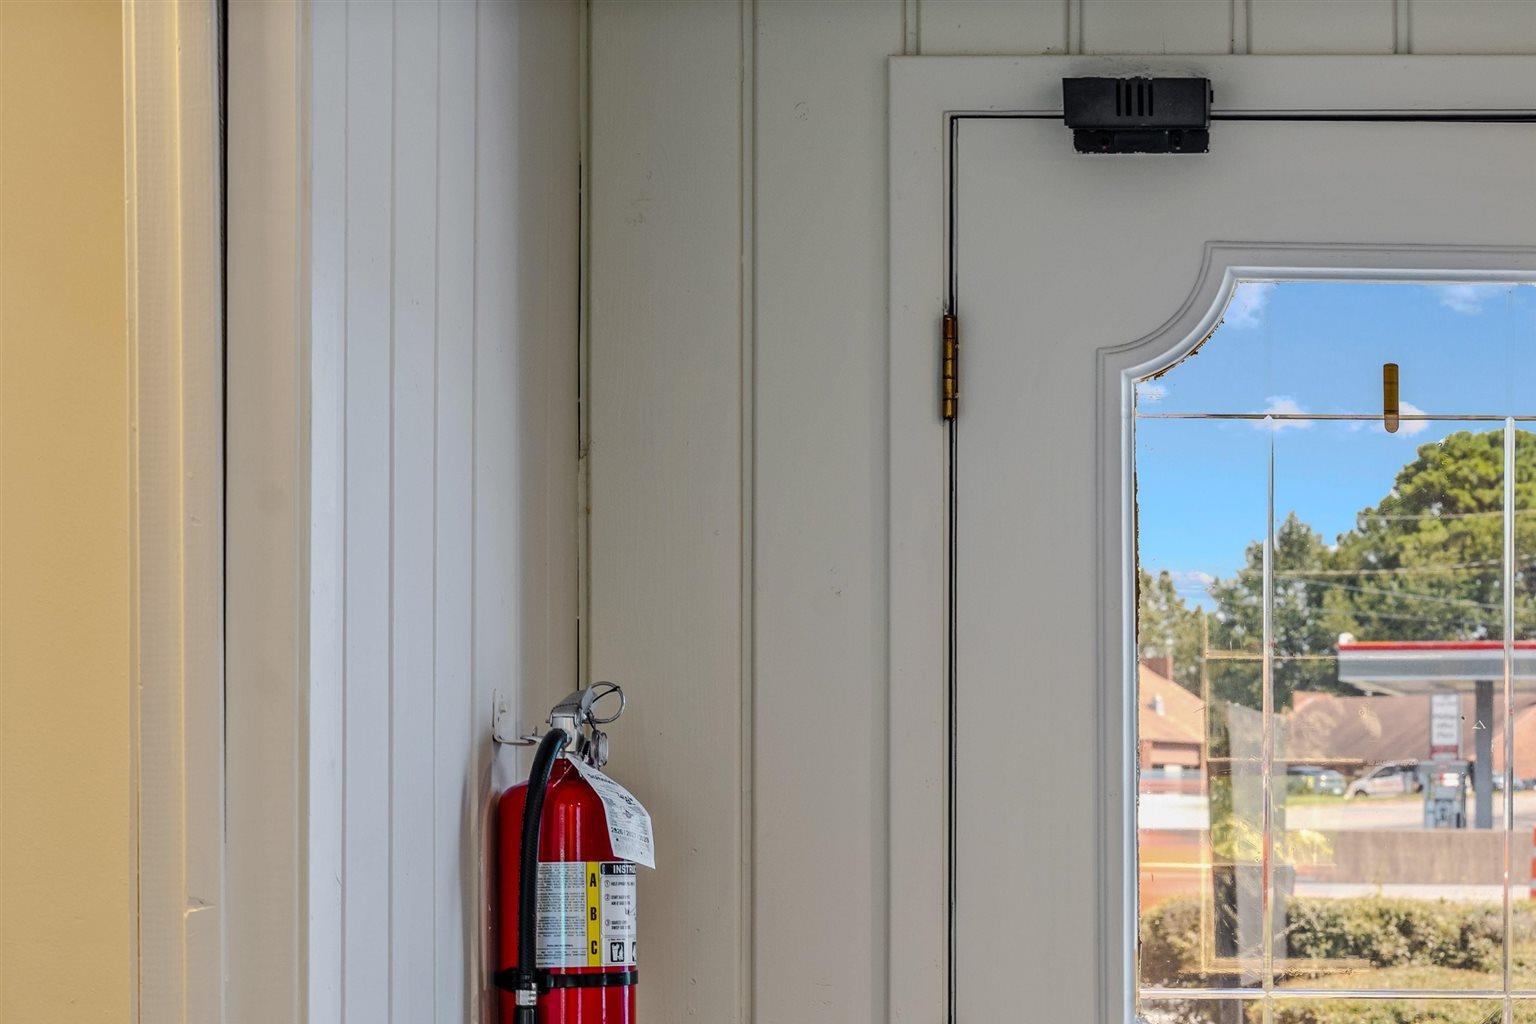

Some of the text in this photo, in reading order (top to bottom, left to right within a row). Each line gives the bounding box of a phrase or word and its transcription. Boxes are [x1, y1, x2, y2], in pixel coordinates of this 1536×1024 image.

[590, 873, 597, 887] A
[590, 907, 597, 920] B
[591, 940, 598, 955] C
